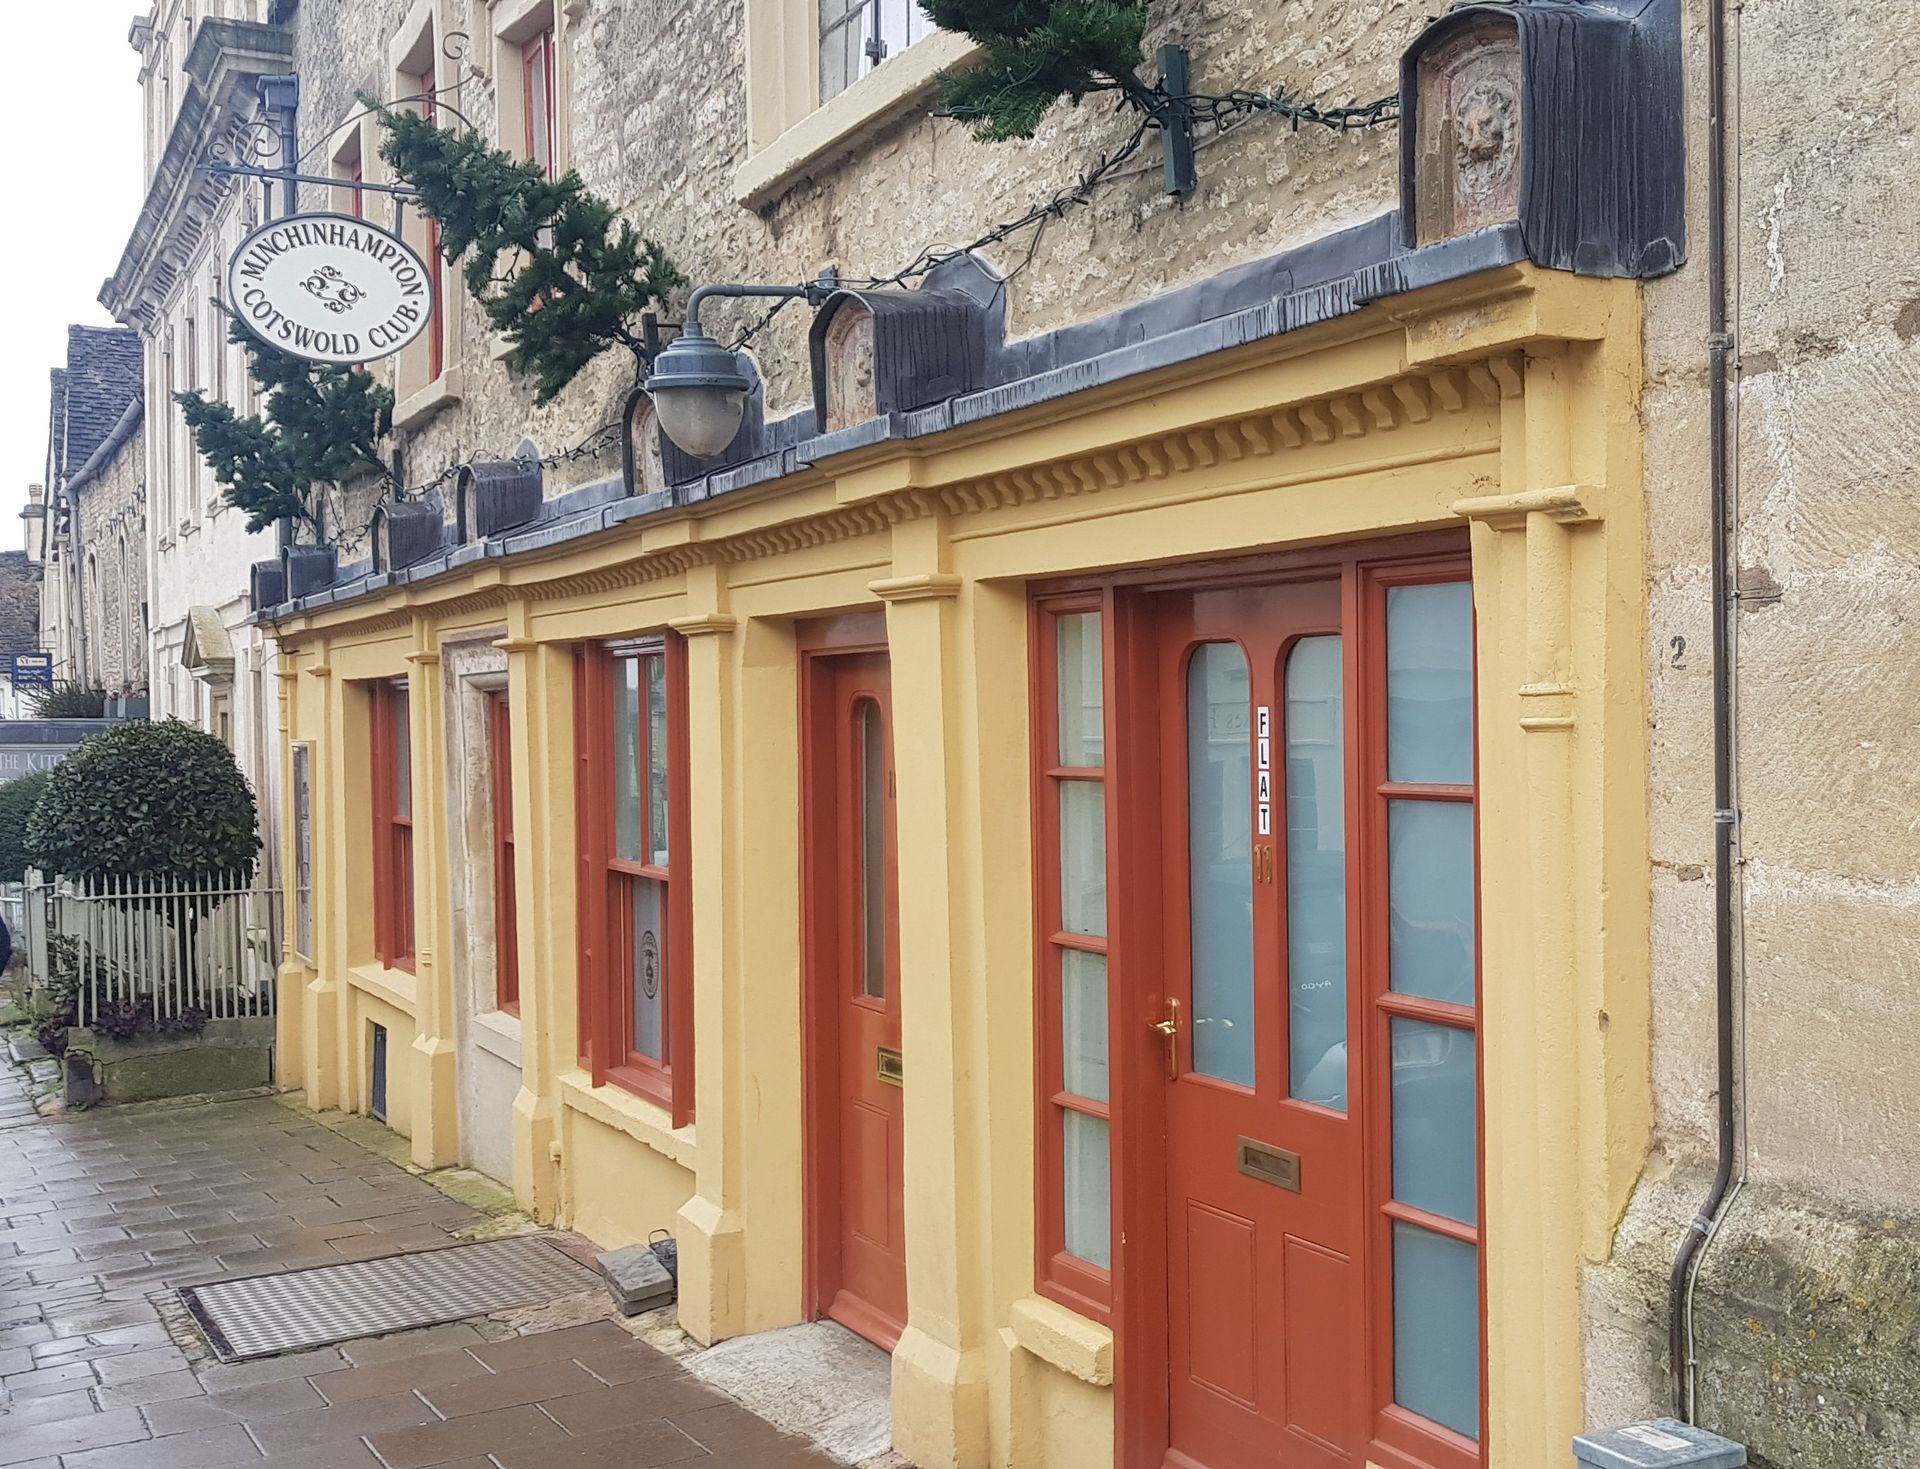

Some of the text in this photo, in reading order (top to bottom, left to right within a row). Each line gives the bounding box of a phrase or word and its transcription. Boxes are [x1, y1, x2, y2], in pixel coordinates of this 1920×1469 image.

[240, 223, 424, 297] MINCHINHAMPTON
[244, 288, 419, 355] COTSWOLD CLUB
[1670, 636, 1687, 670] 2
[1259, 712, 1269, 831] FLAT
[1254, 844, 1272, 883] 11
